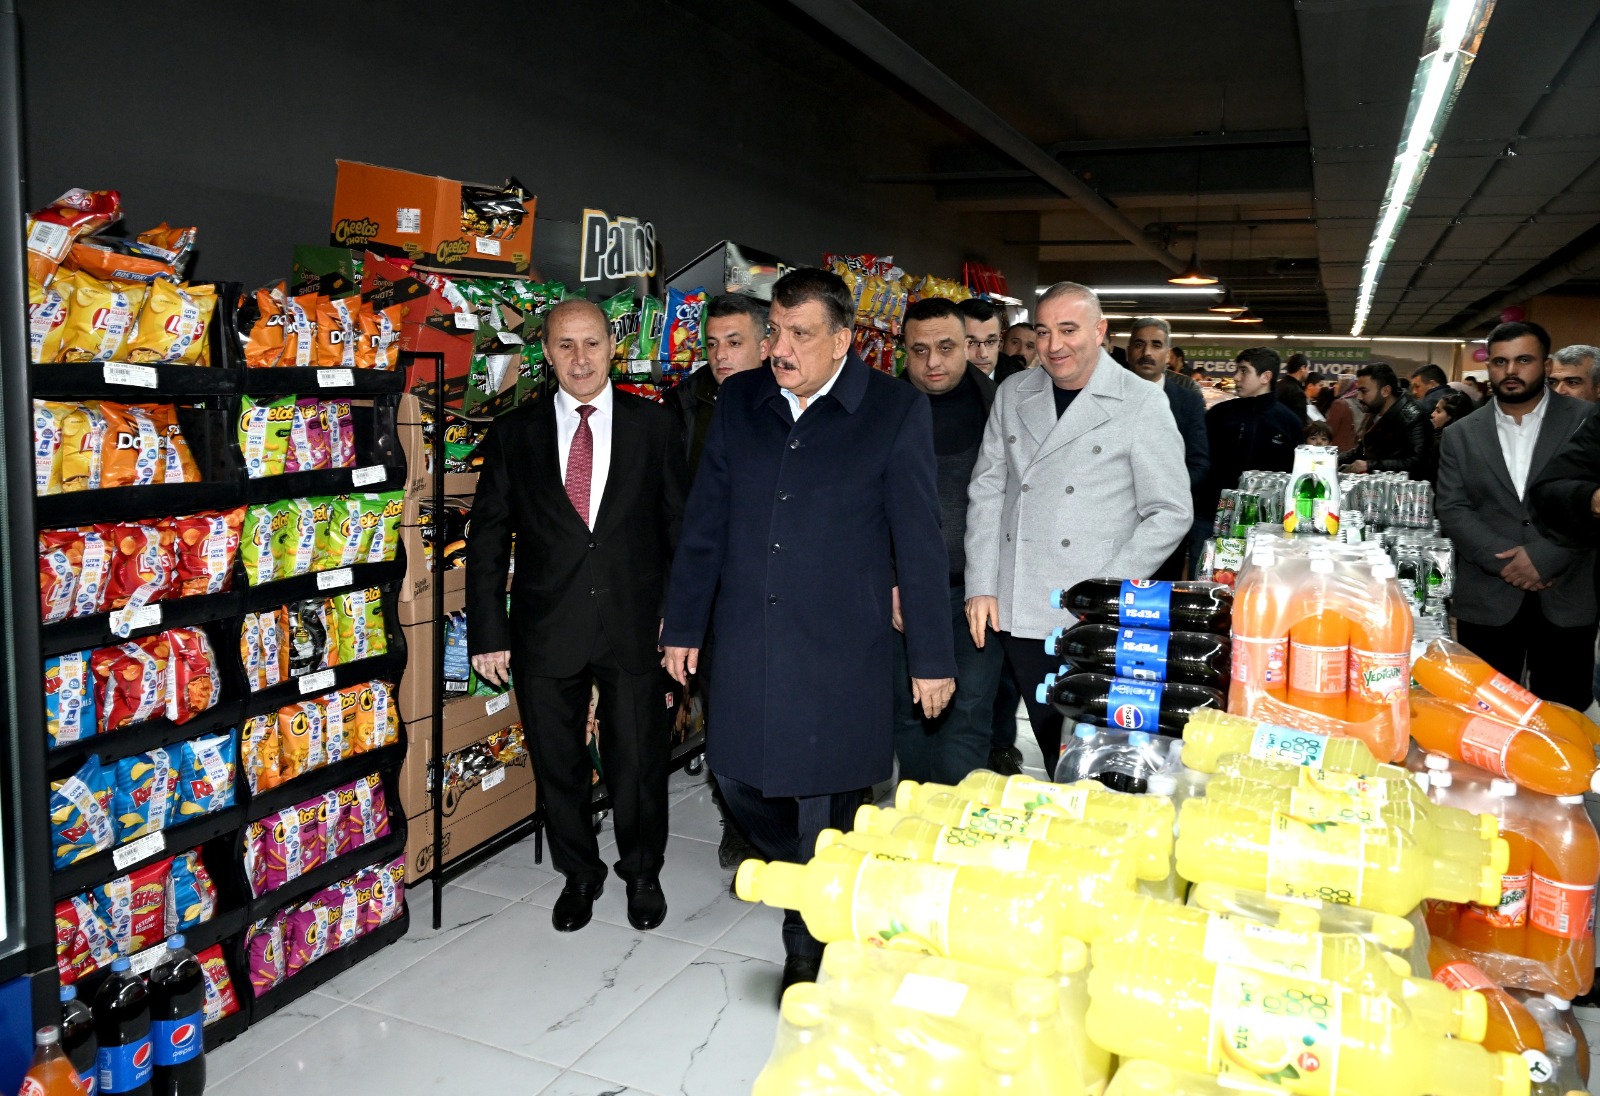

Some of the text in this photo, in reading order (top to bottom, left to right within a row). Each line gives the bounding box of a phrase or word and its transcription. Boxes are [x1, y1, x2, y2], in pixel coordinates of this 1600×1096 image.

[336, 218, 379, 242] Cheetos
[346, 236, 368, 246] SHOTS
[436, 237, 470, 262] Cheetos
[444, 256, 462, 264] SHOTS
[299, 282, 320, 295] SHOTS
[1126, 609, 1160, 618] PEPSI
[1123, 642, 1158, 653] PEPSI
[172, 1046, 194, 1061] pepsi
